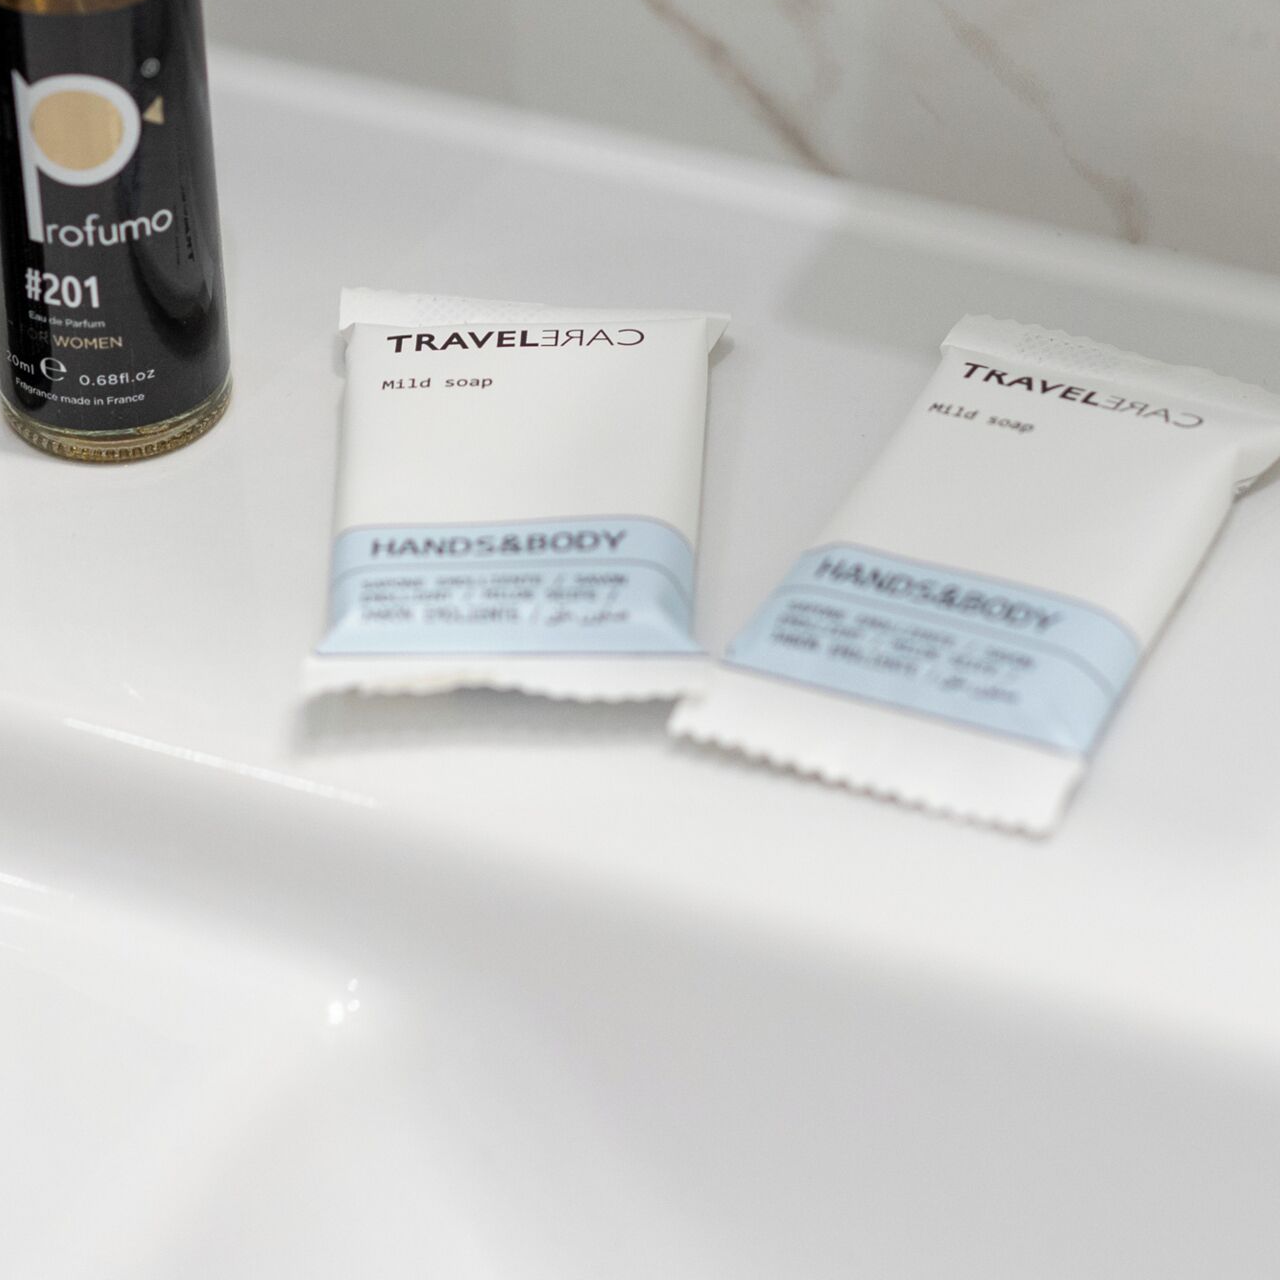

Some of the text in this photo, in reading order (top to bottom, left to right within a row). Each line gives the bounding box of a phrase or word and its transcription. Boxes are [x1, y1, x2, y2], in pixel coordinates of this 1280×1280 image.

[24, 267, 101, 309] #201
[28, 309, 107, 329] Eau de Parfum
[52, 334, 124, 350] WOMEN
[15, 377, 146, 406] Fragrance made in France
[381, 377, 494, 391] Mild soap
[928, 402, 1035, 434] Mild soap
[370, 529, 627, 557] HANDS&BODY
[812, 555, 1064, 633] HANDS&BODY
